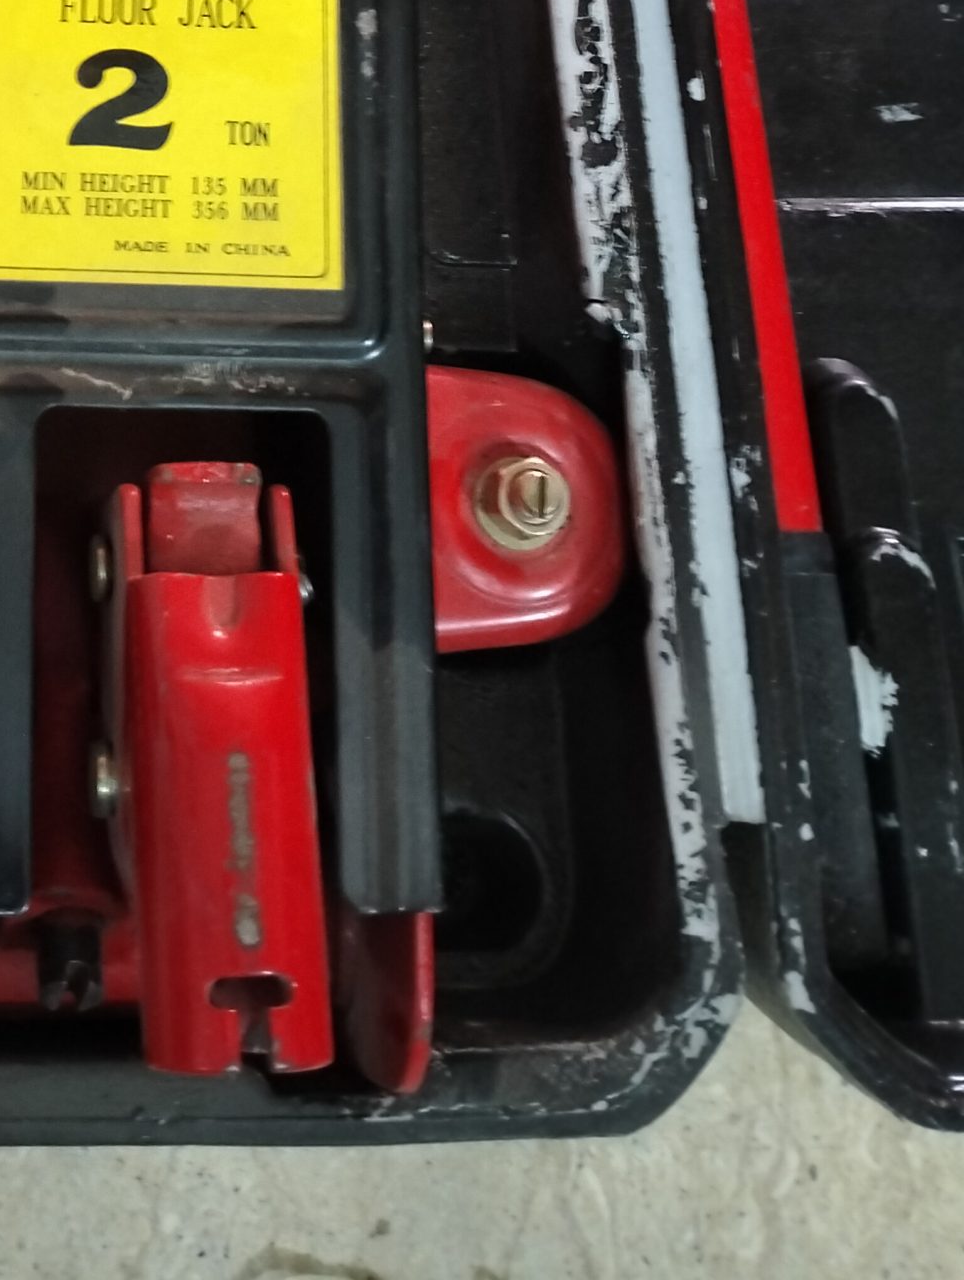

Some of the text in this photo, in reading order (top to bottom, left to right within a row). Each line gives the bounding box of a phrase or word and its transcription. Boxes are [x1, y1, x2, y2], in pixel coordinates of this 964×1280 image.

[67, 48, 174, 151] 2
[226, 120, 271, 147] TON
[21, 171, 279, 198] MIN HEIGHT 135 MM
[20, 195, 280, 221] MAX HEIGHT 356 MM
[113, 239, 291, 258] MADE IN CHINA
